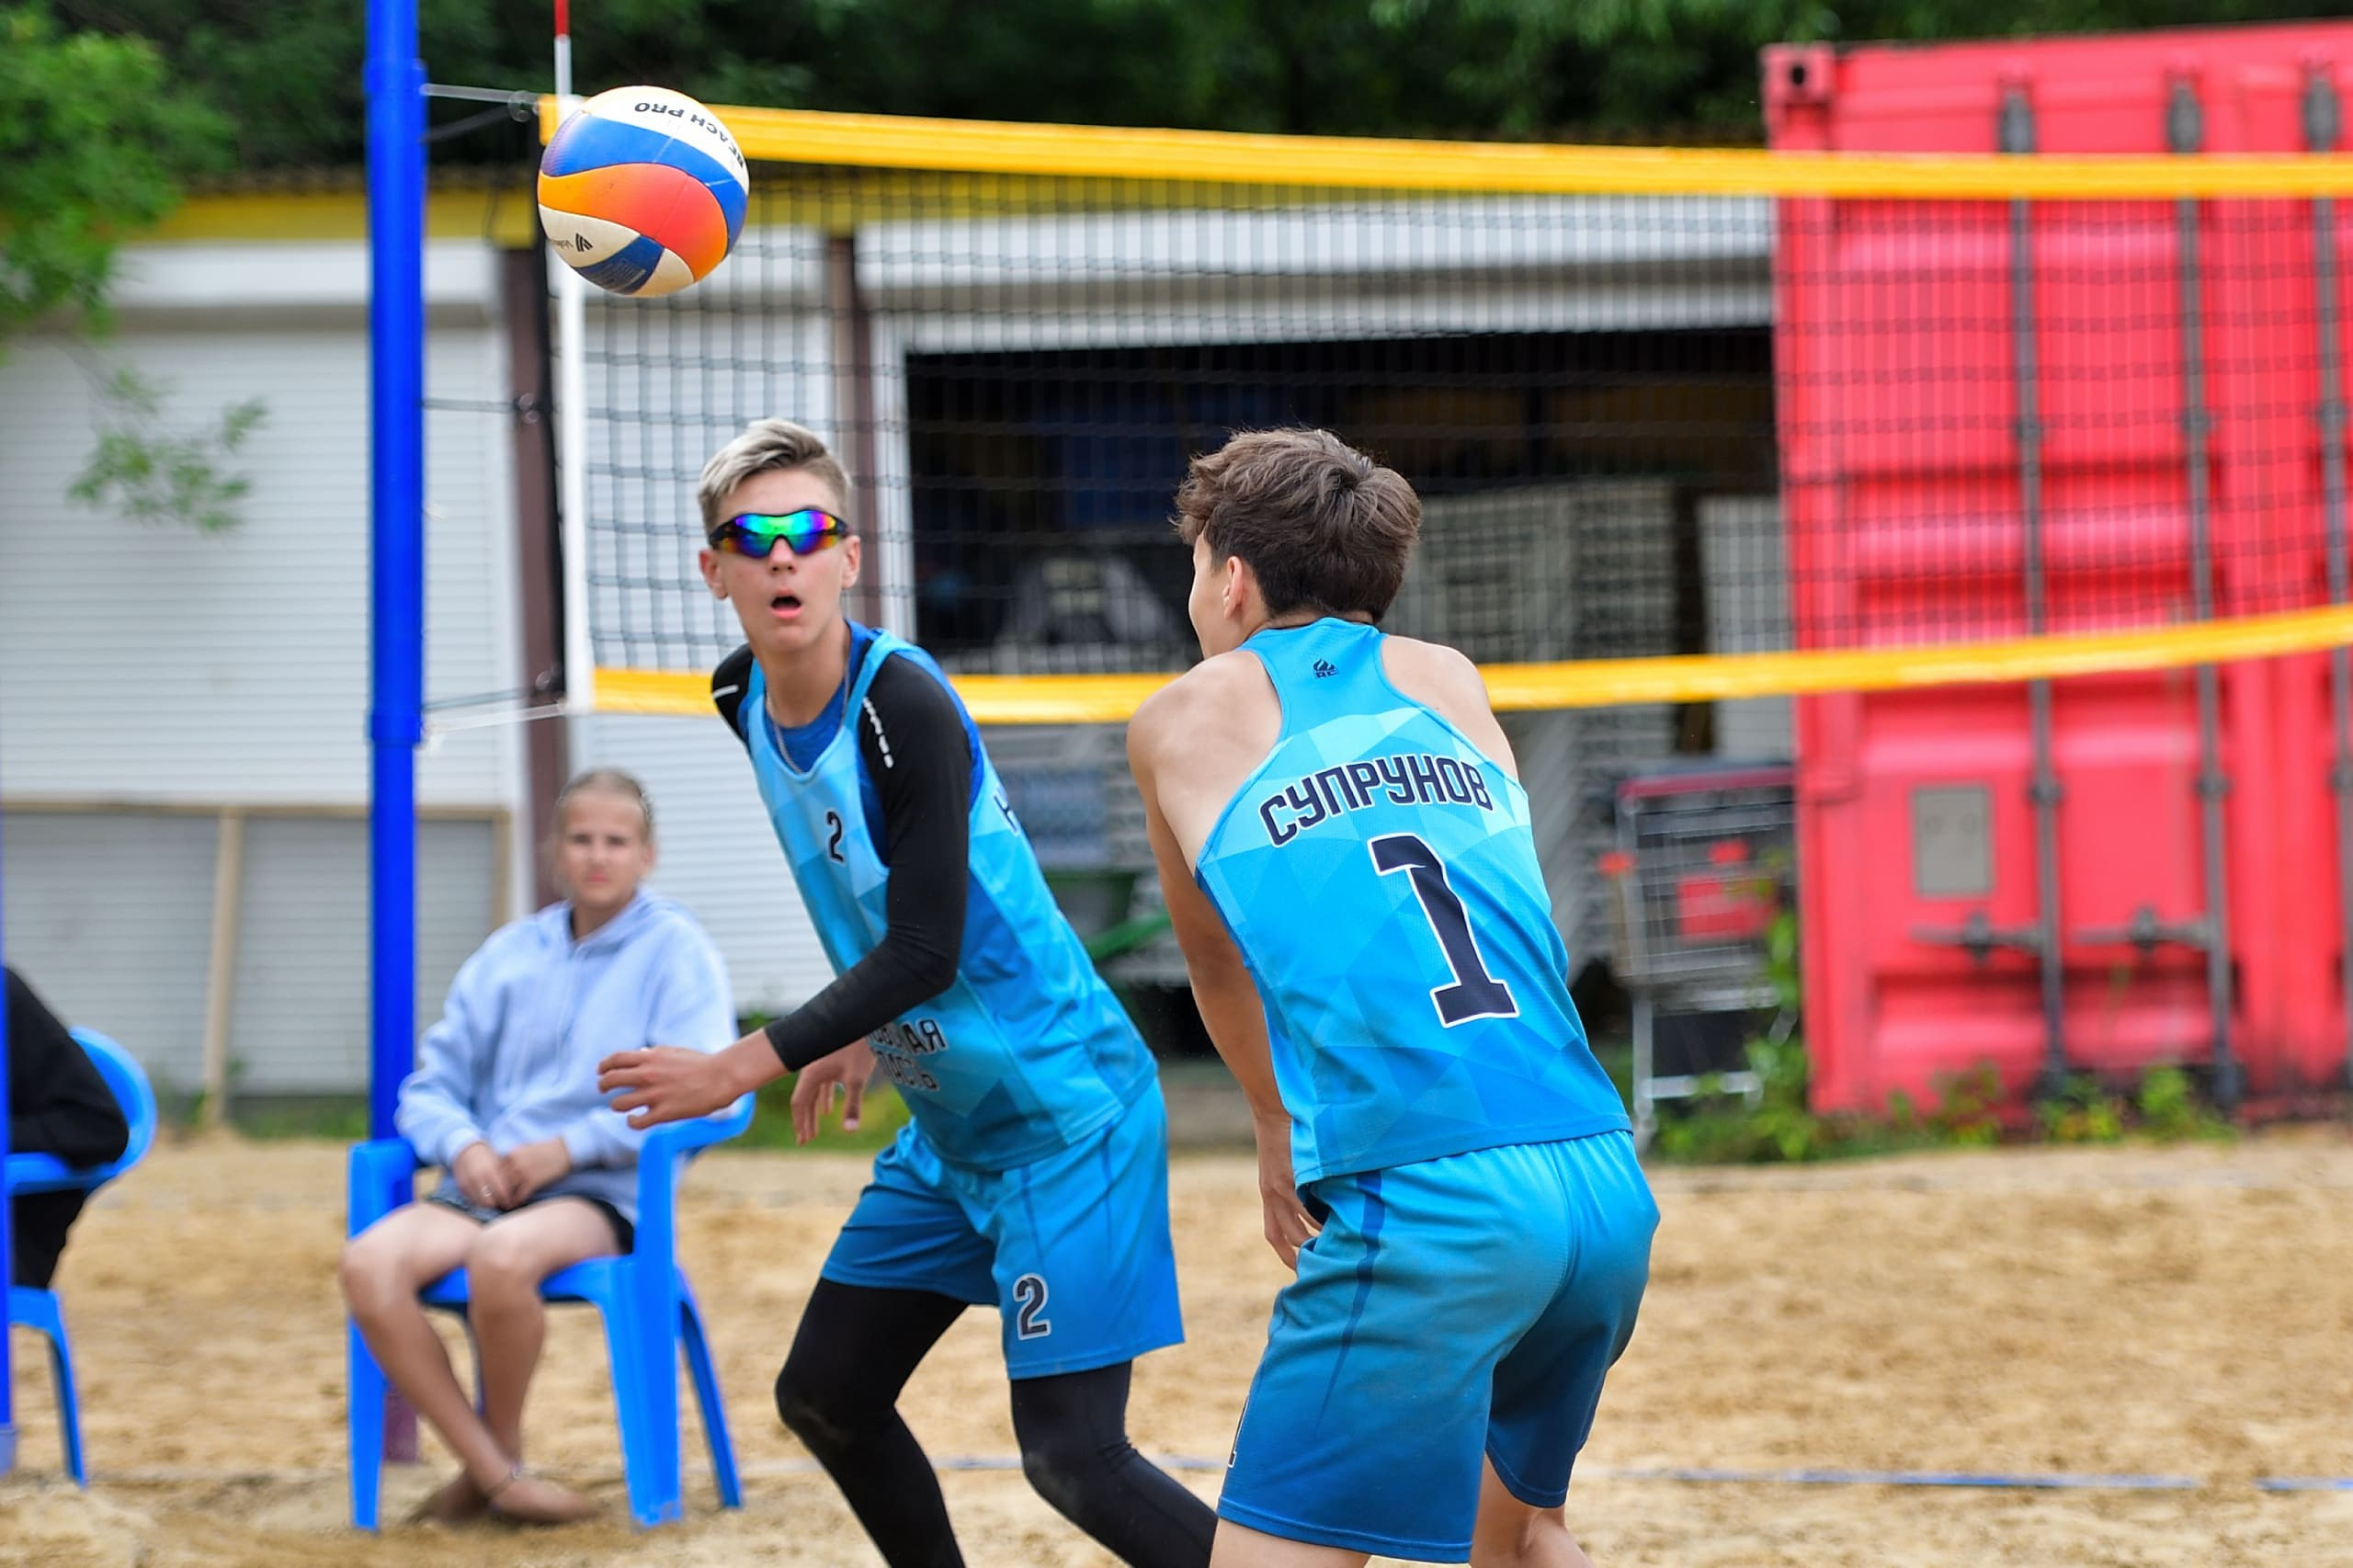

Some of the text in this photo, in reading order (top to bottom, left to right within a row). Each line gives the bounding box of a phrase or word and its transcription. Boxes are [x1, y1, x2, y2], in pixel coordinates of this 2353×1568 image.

[634, 102, 745, 169] BEACH PRO
[1258, 754, 1495, 846] СУПРУНОВ
[826, 810, 847, 865] 2
[1367, 832, 1520, 1028] 1
[1013, 1272, 1051, 1341] 2
